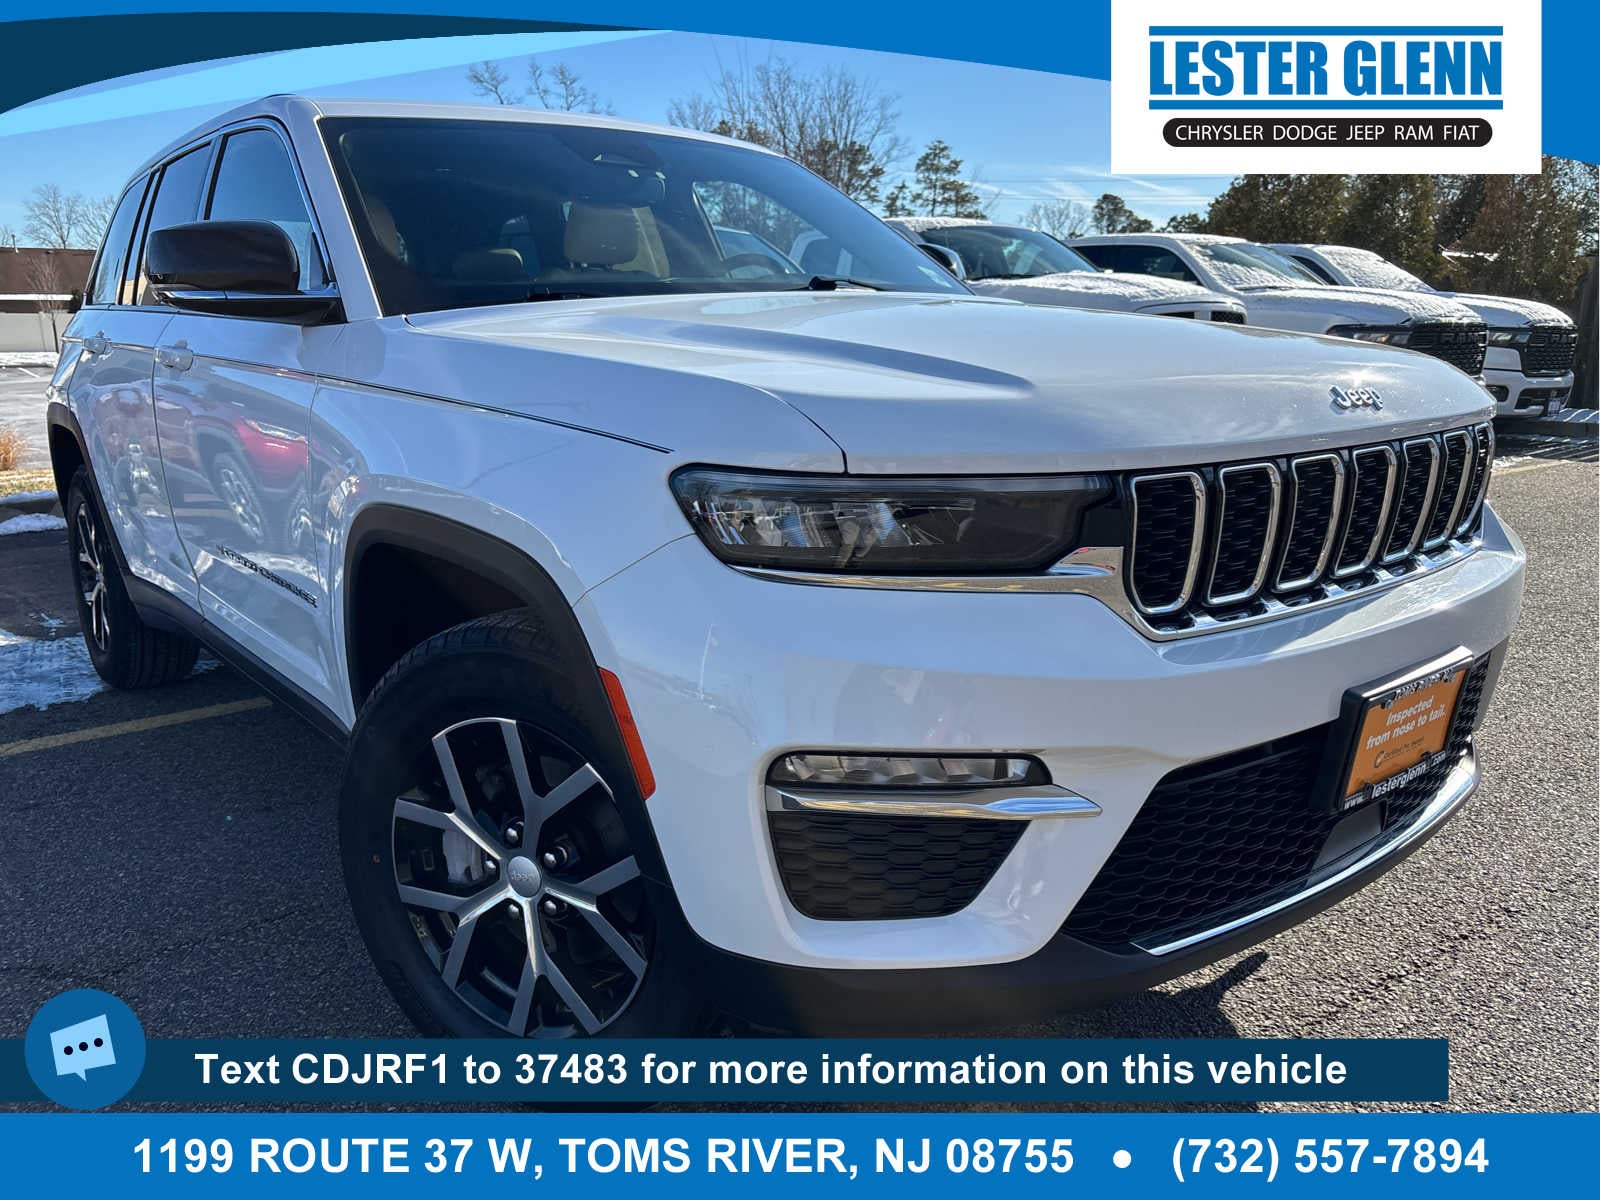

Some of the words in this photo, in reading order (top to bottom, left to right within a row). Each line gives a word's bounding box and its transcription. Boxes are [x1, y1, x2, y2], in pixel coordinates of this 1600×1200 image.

[1328, 385, 1384, 411] Jeep
[1366, 730, 1391, 750] from
[1392, 720, 1416, 738] nose
[1417, 714, 1427, 727] to
[1429, 704, 1445, 721] tail.
[1386, 695, 1434, 726] Inspected
[1371, 763, 1427, 799] lesterglenn
